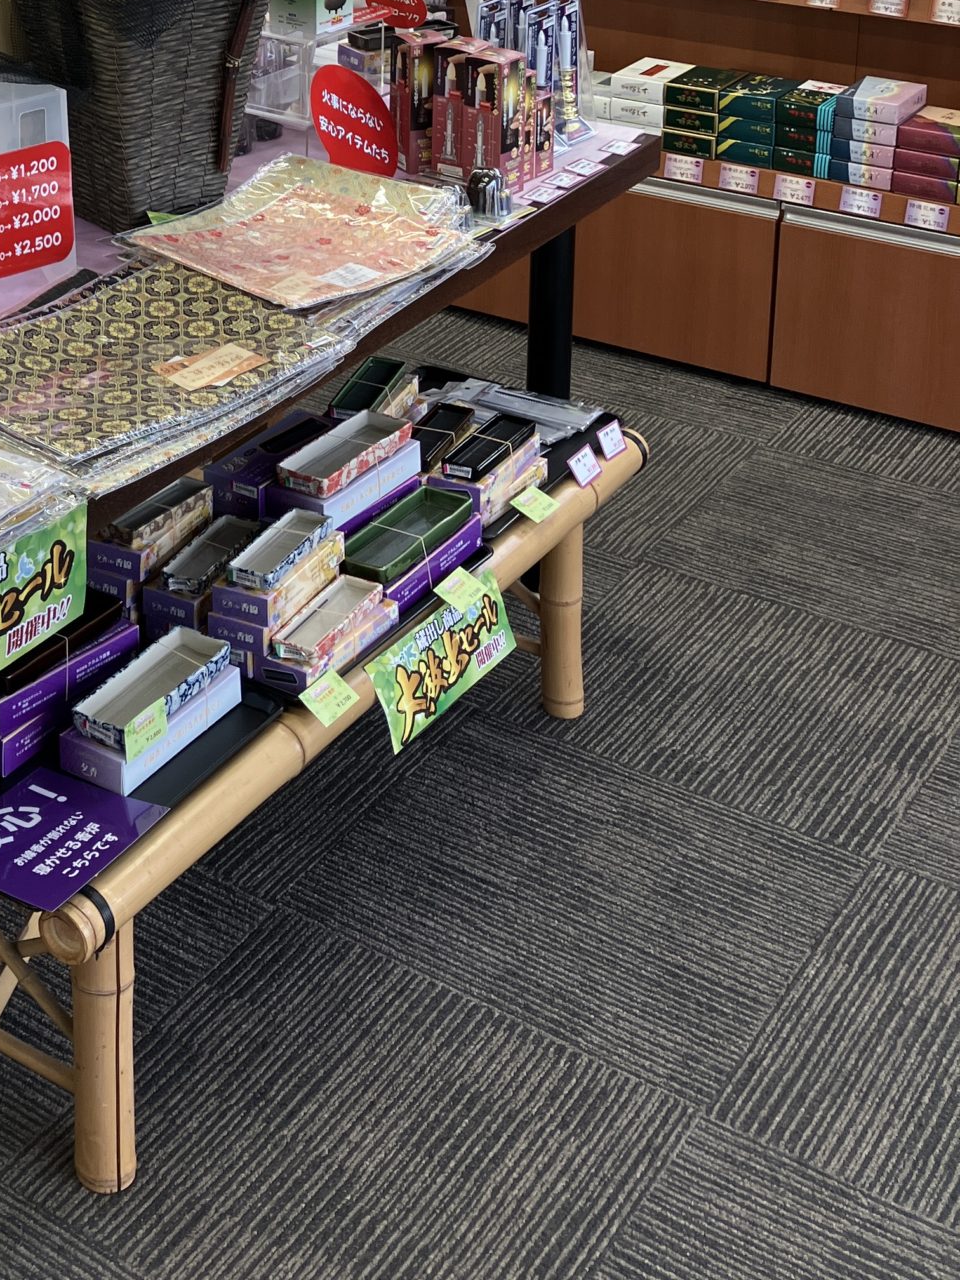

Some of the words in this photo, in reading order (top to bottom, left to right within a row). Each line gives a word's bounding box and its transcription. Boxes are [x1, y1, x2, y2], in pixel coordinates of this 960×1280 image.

[321, 89, 384, 132] 火事にならない
[318, 114, 390, 164] 安心アイテムたち
[10, 156, 57, 181] ¥1,200
[11, 180, 59, 205] ¥1,700
[12, 205, 61, 230] ¥2,000
[14, 232, 62, 257] ¥2,500
[395, 593, 498, 747] 大放出セール
[12, 810, 84, 867] お線香が倒れない
[32, 821, 102, 877] 寝かせる香炉
[61, 832, 119, 879] こちらです
